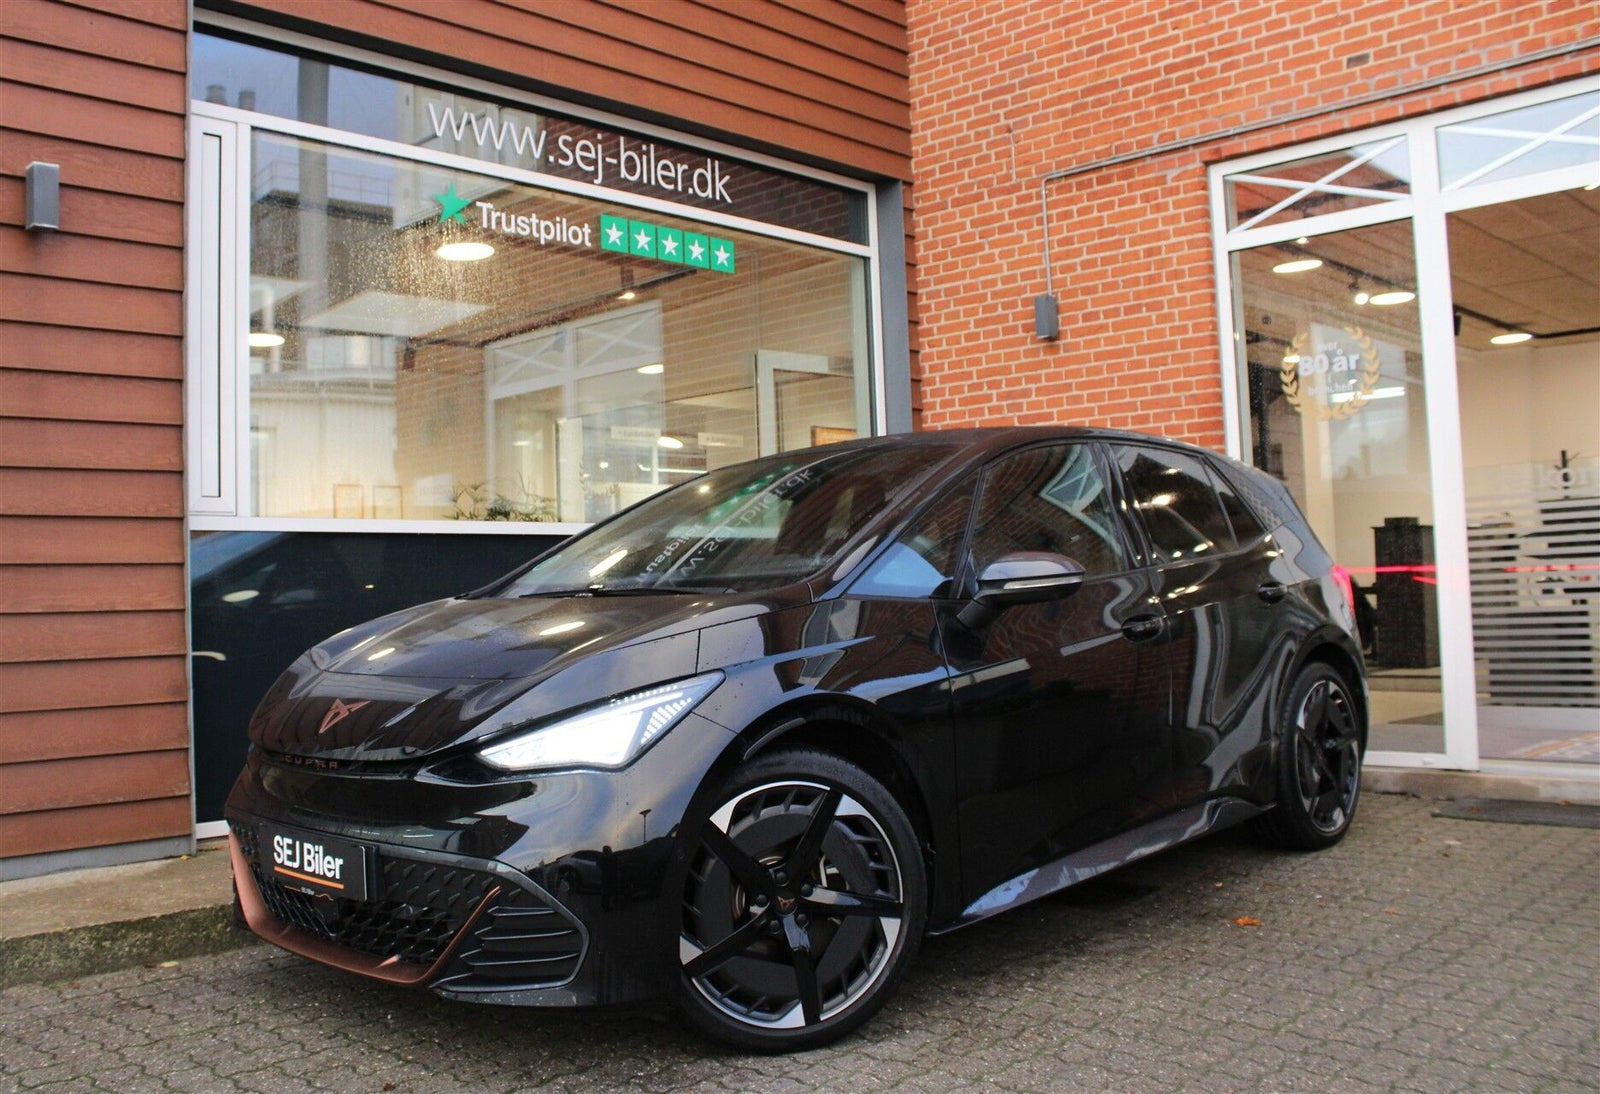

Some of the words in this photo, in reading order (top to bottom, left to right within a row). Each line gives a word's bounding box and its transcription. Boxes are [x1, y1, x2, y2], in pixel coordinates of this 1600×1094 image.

[429, 103, 733, 204] www.sej-biler.dk
[476, 201, 592, 247] Trustpilot
[1298, 353, 1329, 376] 80
[1332, 348, 1360, 372] år
[282, 753, 338, 769] CUPRA
[273, 834, 300, 869] SEJ
[303, 842, 344, 880] Biler
